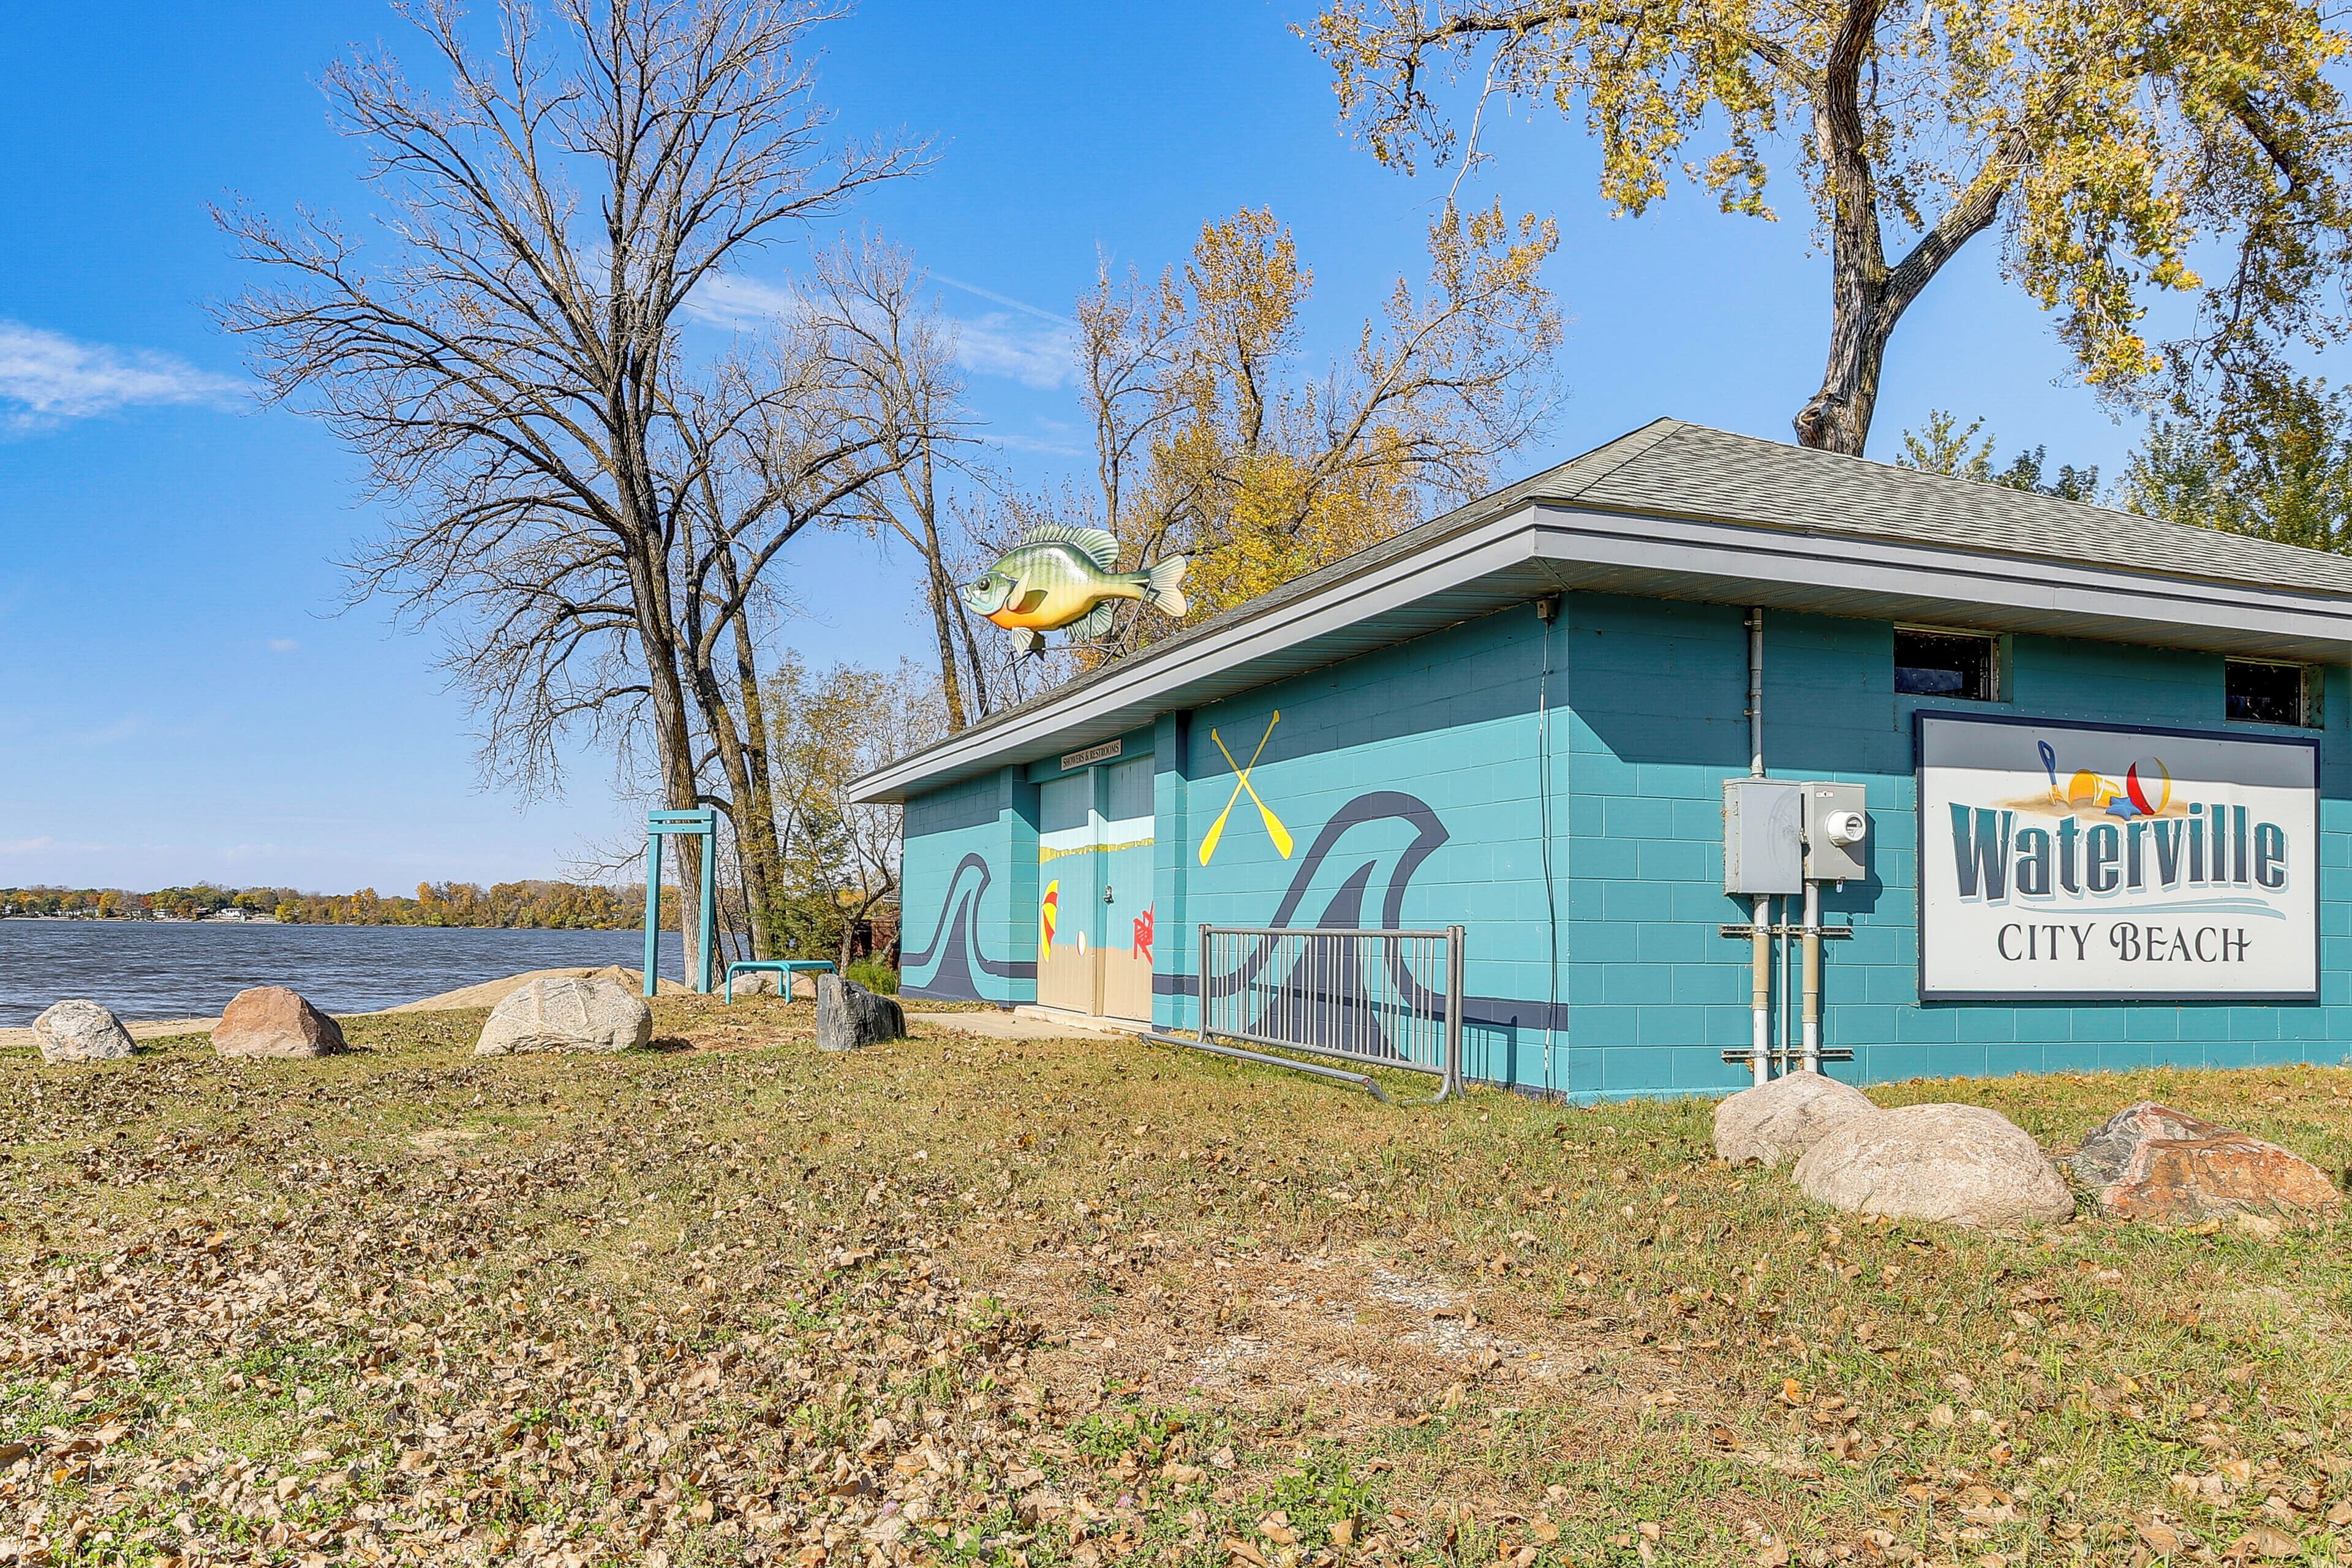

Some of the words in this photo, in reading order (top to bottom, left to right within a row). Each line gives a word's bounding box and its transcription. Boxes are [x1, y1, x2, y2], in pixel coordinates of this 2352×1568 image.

[1063, 753, 1084, 767] SHOWERS
[1085, 751, 1089, 761] &
[1090, 743, 1119, 759] RESTROOMS
[1948, 802, 2288, 903] Waterville
[1997, 922, 2096, 962] CITY
[2109, 921, 2252, 963] BEACH
